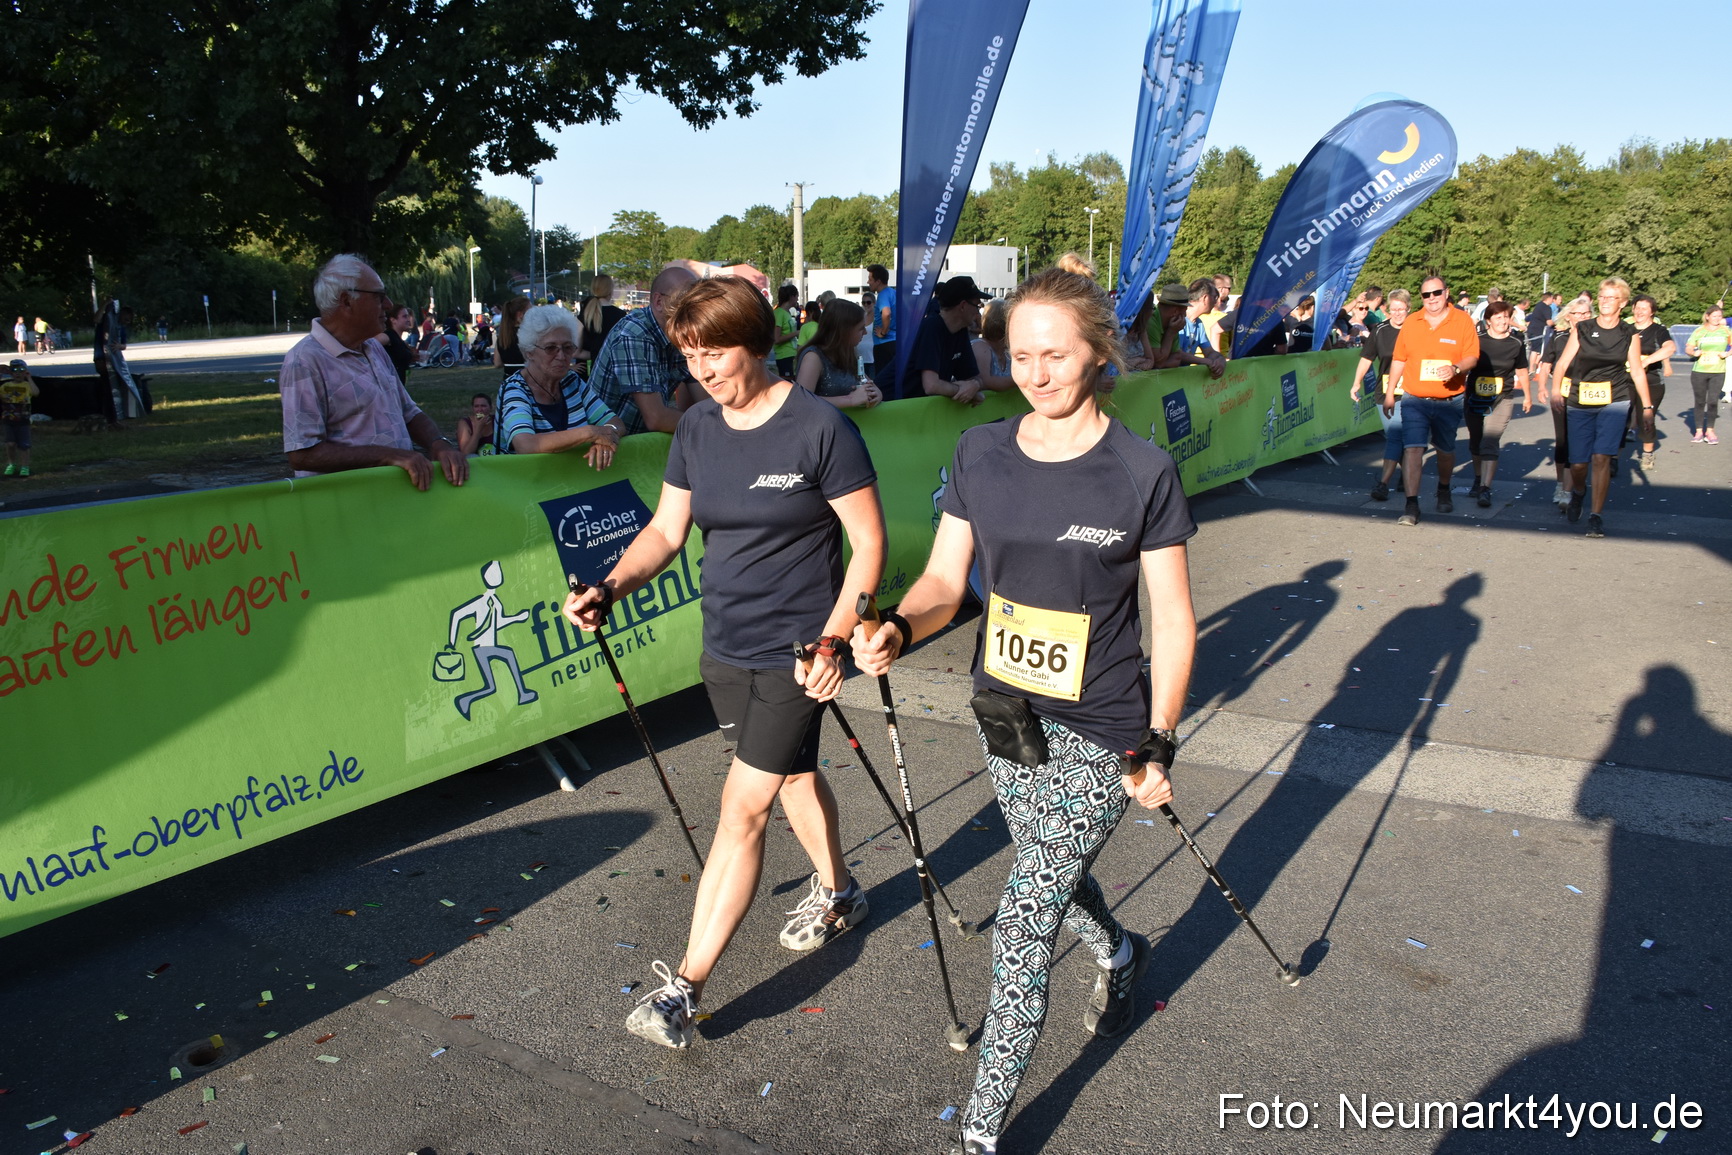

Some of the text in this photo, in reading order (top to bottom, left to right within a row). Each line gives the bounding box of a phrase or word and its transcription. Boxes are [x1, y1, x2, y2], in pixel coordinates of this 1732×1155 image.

[912, 35, 1004, 296] www.fischer-automobile.de
[1350, 152, 1444, 228] Druck und Medien
[1266, 169, 1396, 278] Frischmann
[1478, 383, 1497, 392] 1651
[1583, 390, 1607, 399] 1643
[1169, 405, 1187, 419] Fischer
[574, 509, 638, 542] Fischer
[586, 523, 641, 549] AUTOMOBILE
[1057, 525, 1108, 542] JURA
[108, 522, 263, 590] Firmen
[603, 550, 619, 565] und
[147, 551, 311, 645] länger!
[995, 628, 1069, 673] 1056
[1003, 660, 1050, 681] Nunner Gabi
[1021, 676, 1047, 687] Neumarkt
[888, 727, 905, 767] NORDIC
[897, 767, 914, 812] WALKING
